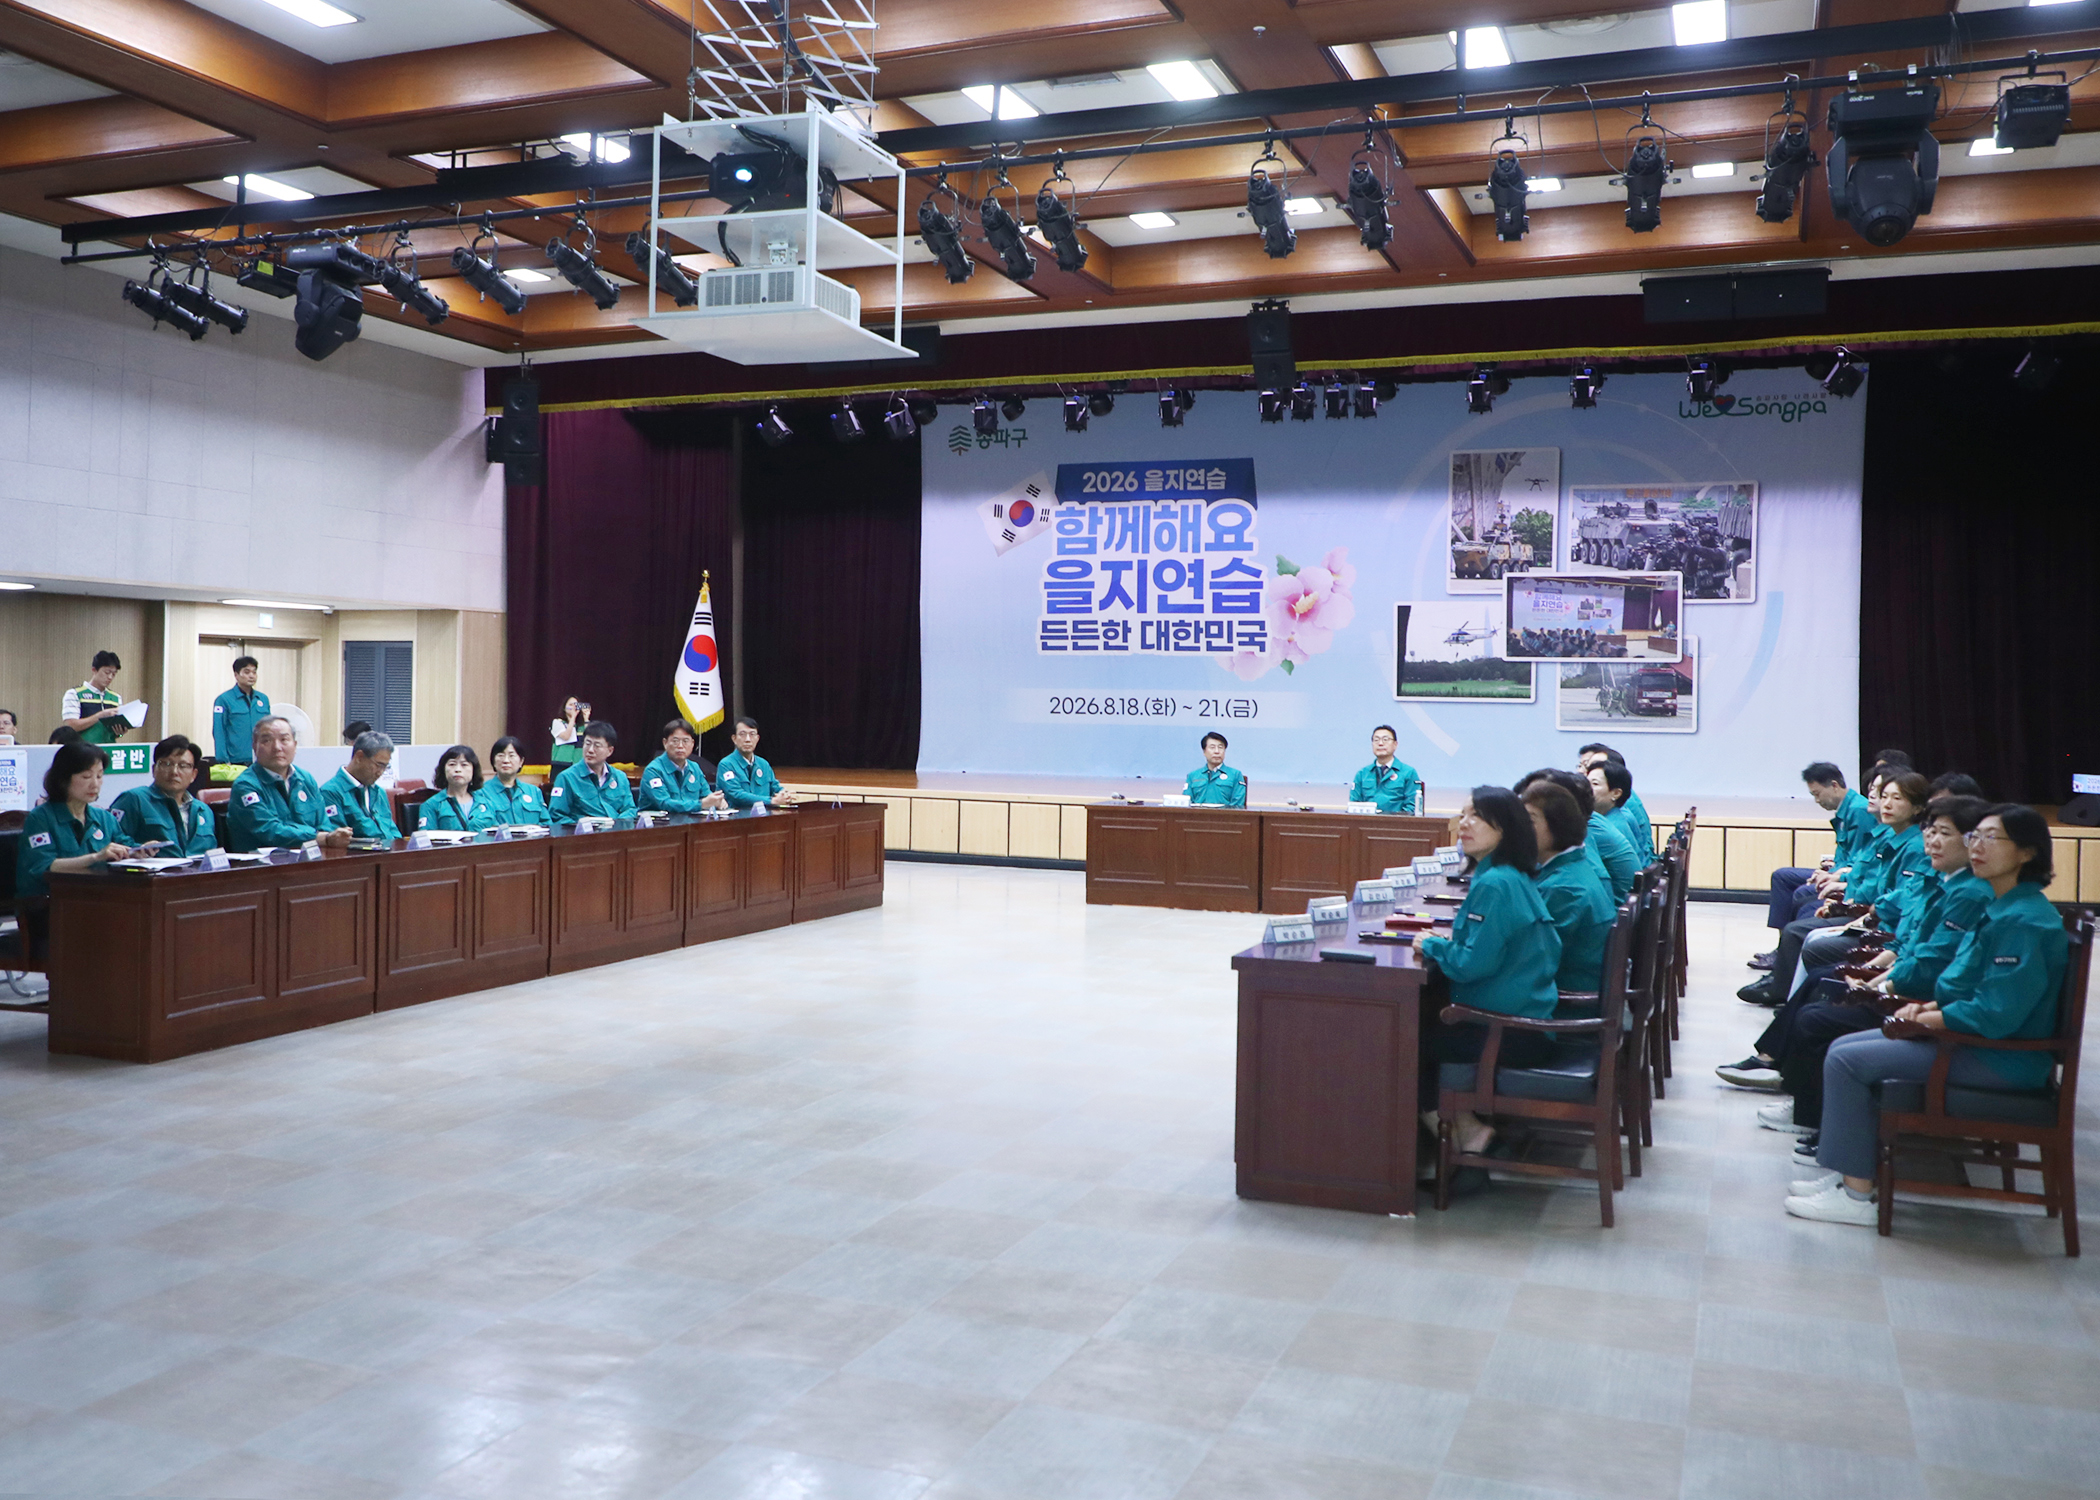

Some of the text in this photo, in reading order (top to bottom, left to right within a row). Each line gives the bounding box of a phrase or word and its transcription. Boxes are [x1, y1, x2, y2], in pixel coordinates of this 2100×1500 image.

[1678, 397, 1827, 423] We Songpa
[976, 427, 1029, 449] 송파구
[1082, 467, 1227, 493] 2026 을지연습
[1054, 503, 1254, 556] 함께해요
[1044, 557, 1264, 614] 을지연습
[1040, 619, 1268, 652] 든든한 대한민국
[1050, 697, 1176, 716] 2026.8.18.(화)
[1199, 698, 1258, 718] 21.(금)
[107, 749, 146, 770] 괄반
